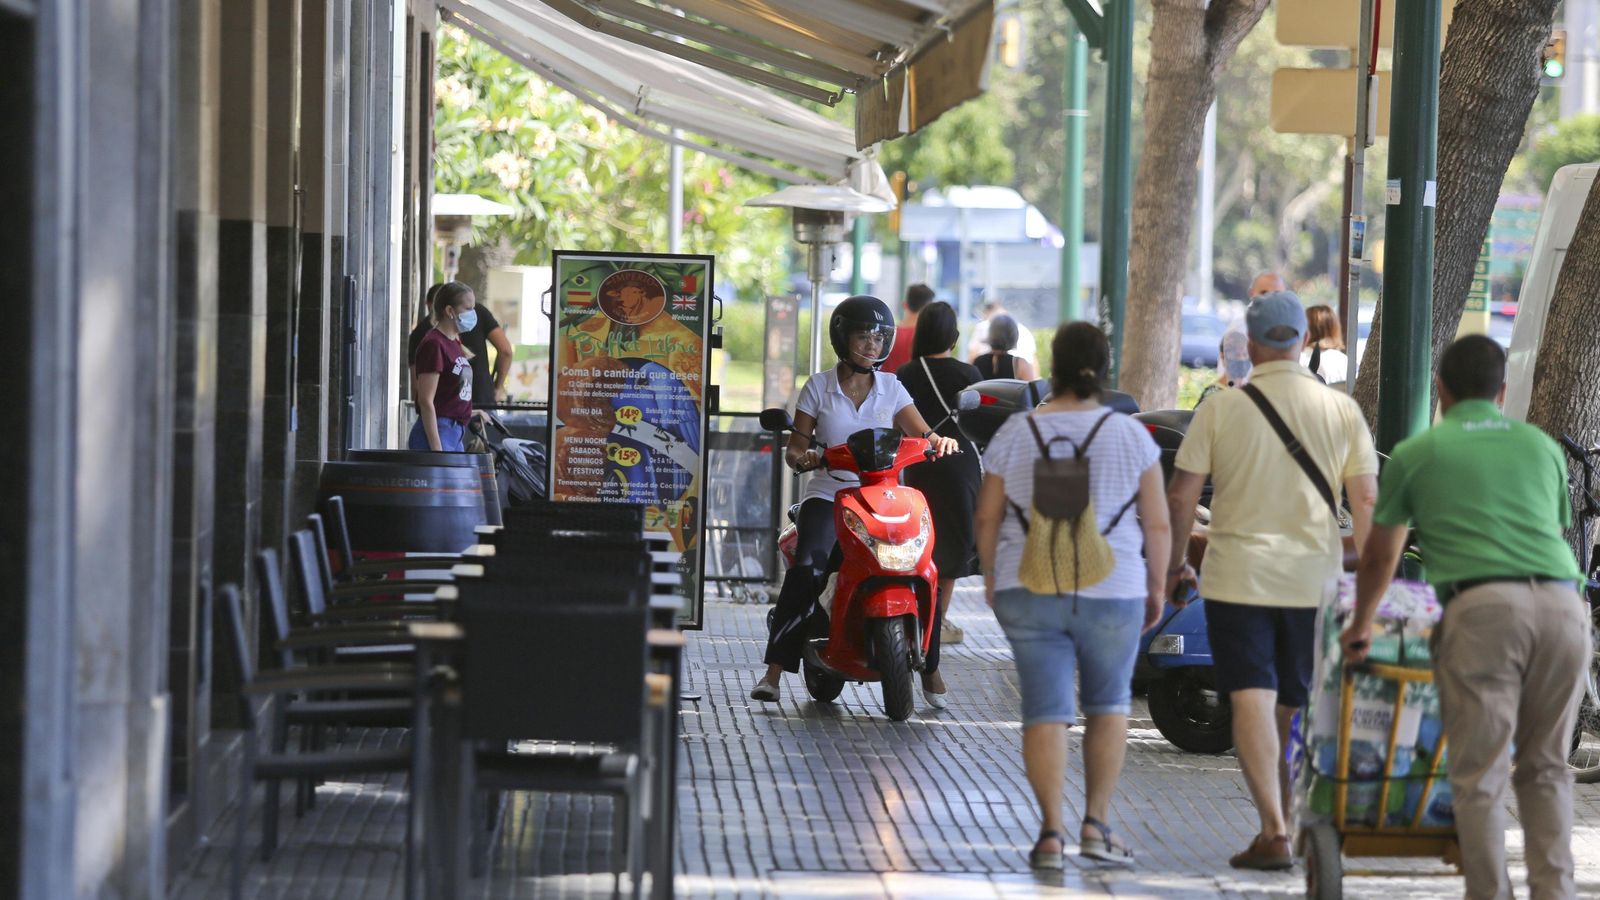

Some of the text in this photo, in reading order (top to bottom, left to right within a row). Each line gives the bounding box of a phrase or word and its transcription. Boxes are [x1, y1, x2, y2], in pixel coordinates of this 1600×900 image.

[672, 314, 699, 322] Welcome
[568, 331, 697, 358] Buffet Libre
[562, 367, 699, 381] Coma la cantidad que desee
[564, 436, 583, 444] MENU
[568, 457, 604, 465] DOMINGOS
[573, 467, 605, 475] FESTIVOS
[558, 478, 588, 486] Tenemos
[603, 481, 618, 489] gran
[596, 488, 619, 496] Zumos
[562, 494, 568, 502] Y
[603, 496, 630, 504] Helados
[635, 497, 661, 505] Postres
